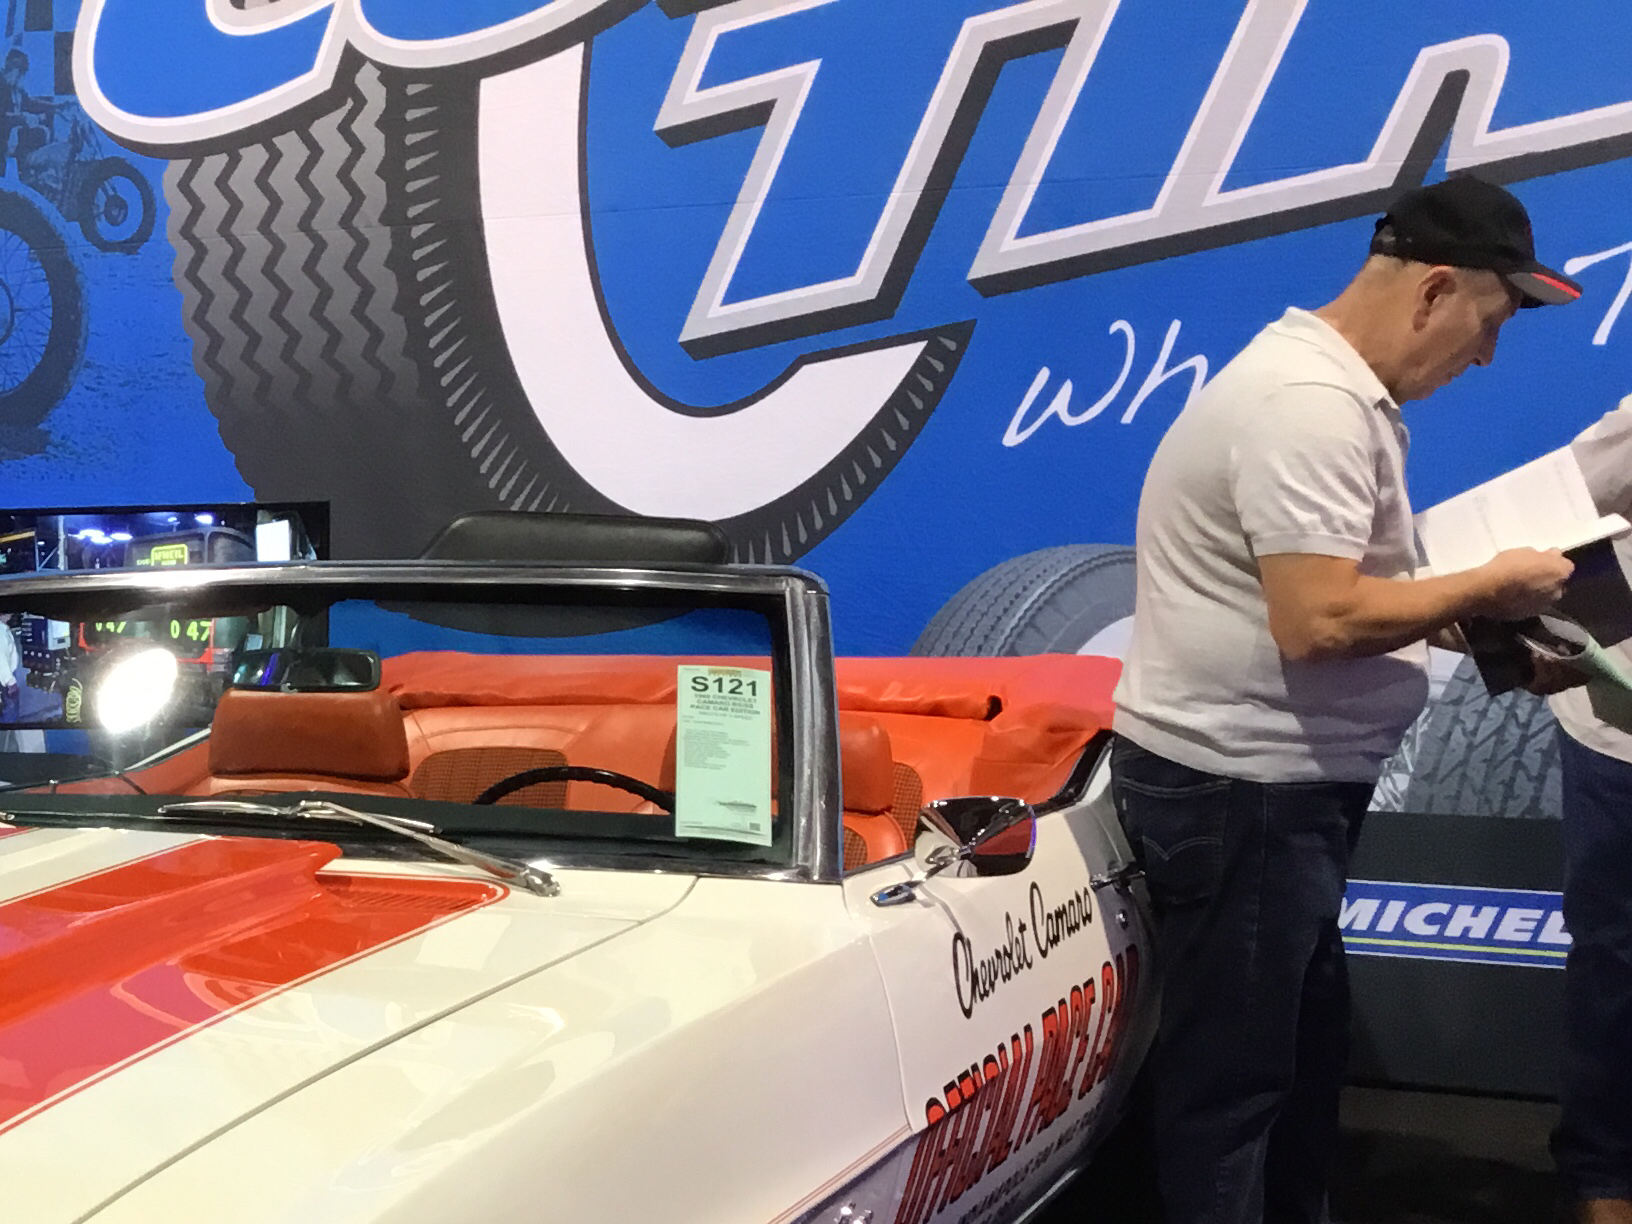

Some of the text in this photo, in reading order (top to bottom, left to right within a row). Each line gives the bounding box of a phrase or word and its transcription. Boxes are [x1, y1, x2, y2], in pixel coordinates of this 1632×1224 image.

[691, 675, 757, 697] S121
[953, 881, 1093, 1019] Chevrolet Camaro
